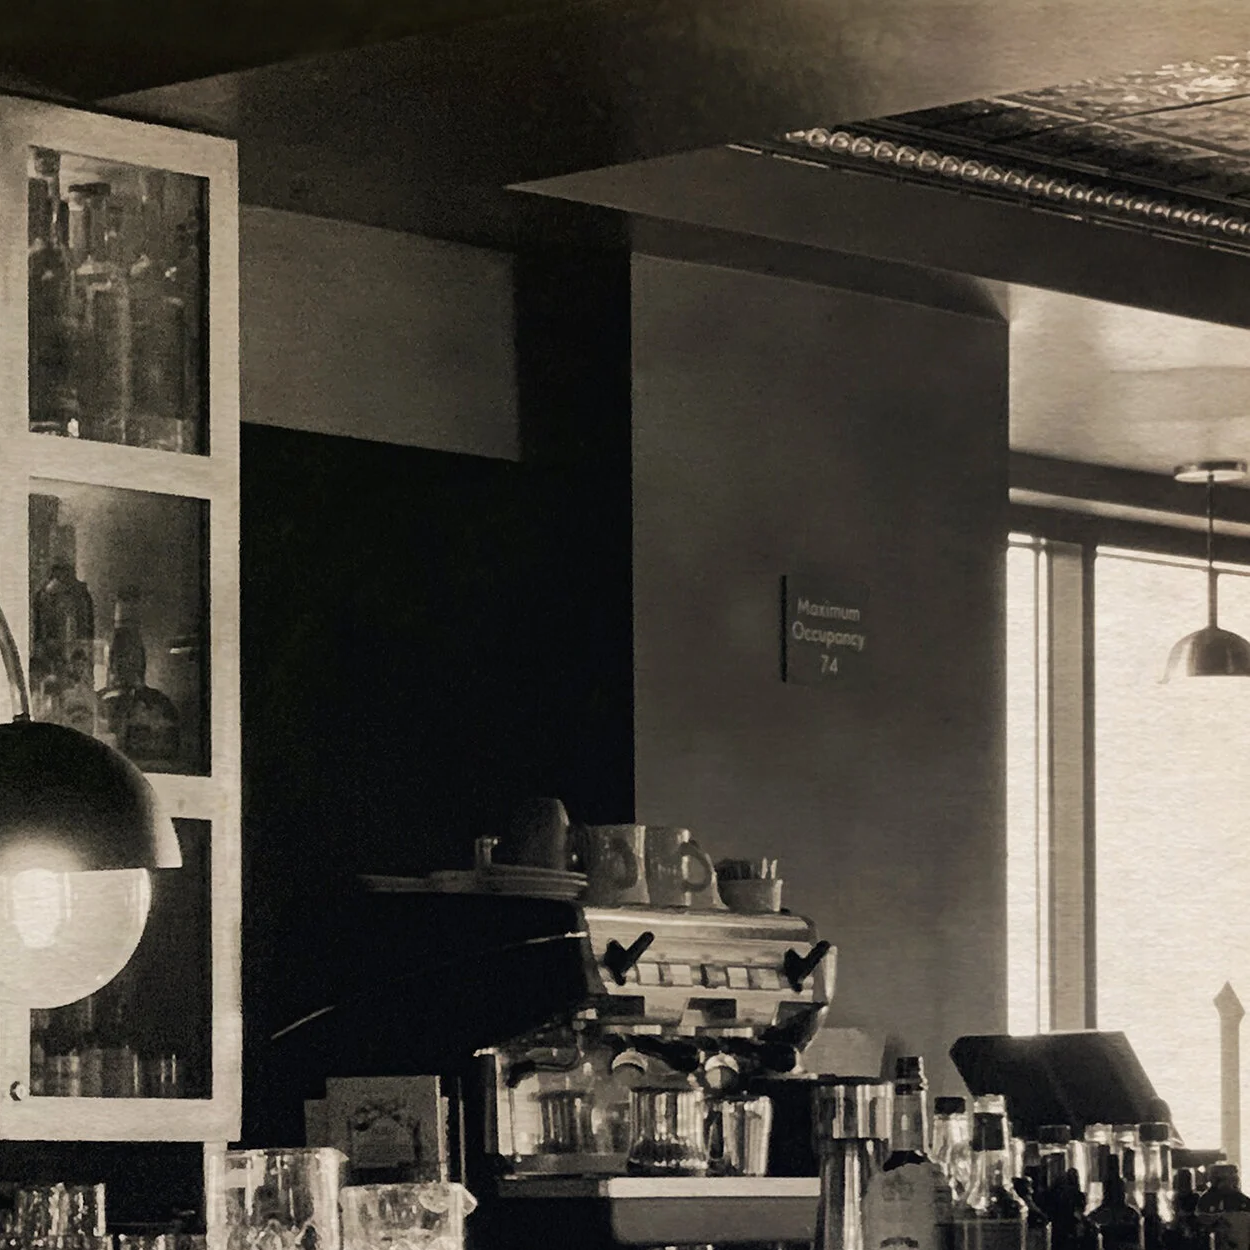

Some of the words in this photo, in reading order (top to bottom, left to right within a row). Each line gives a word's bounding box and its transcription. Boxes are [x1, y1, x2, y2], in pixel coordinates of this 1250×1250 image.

[797, 598, 860, 621] Maximum
[792, 620, 865, 651] Occupancy
[820, 654, 838, 674] 74
